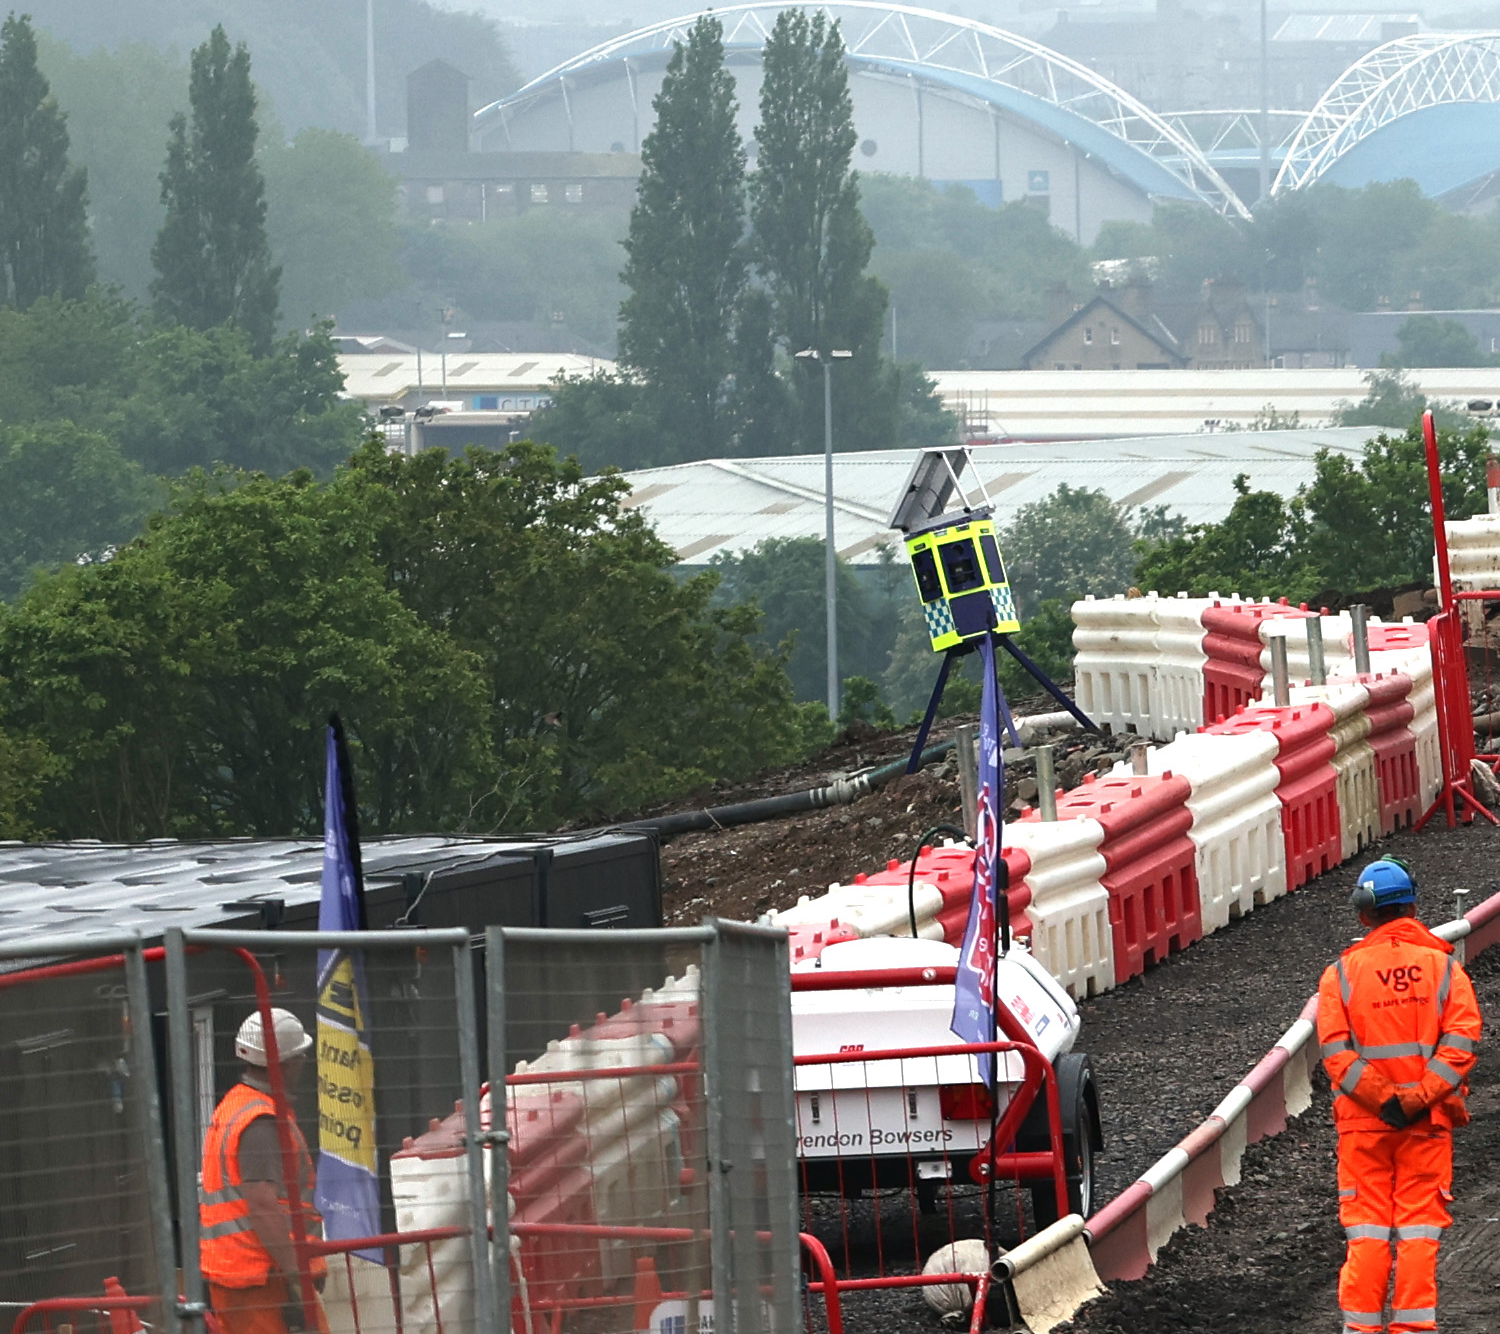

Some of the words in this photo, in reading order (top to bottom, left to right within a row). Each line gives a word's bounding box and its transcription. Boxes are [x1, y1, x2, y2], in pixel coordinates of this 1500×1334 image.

[1375, 965, 1423, 993] vgc
[795, 1129, 863, 1149] rendon
[869, 1127, 954, 1146] Bowsers
